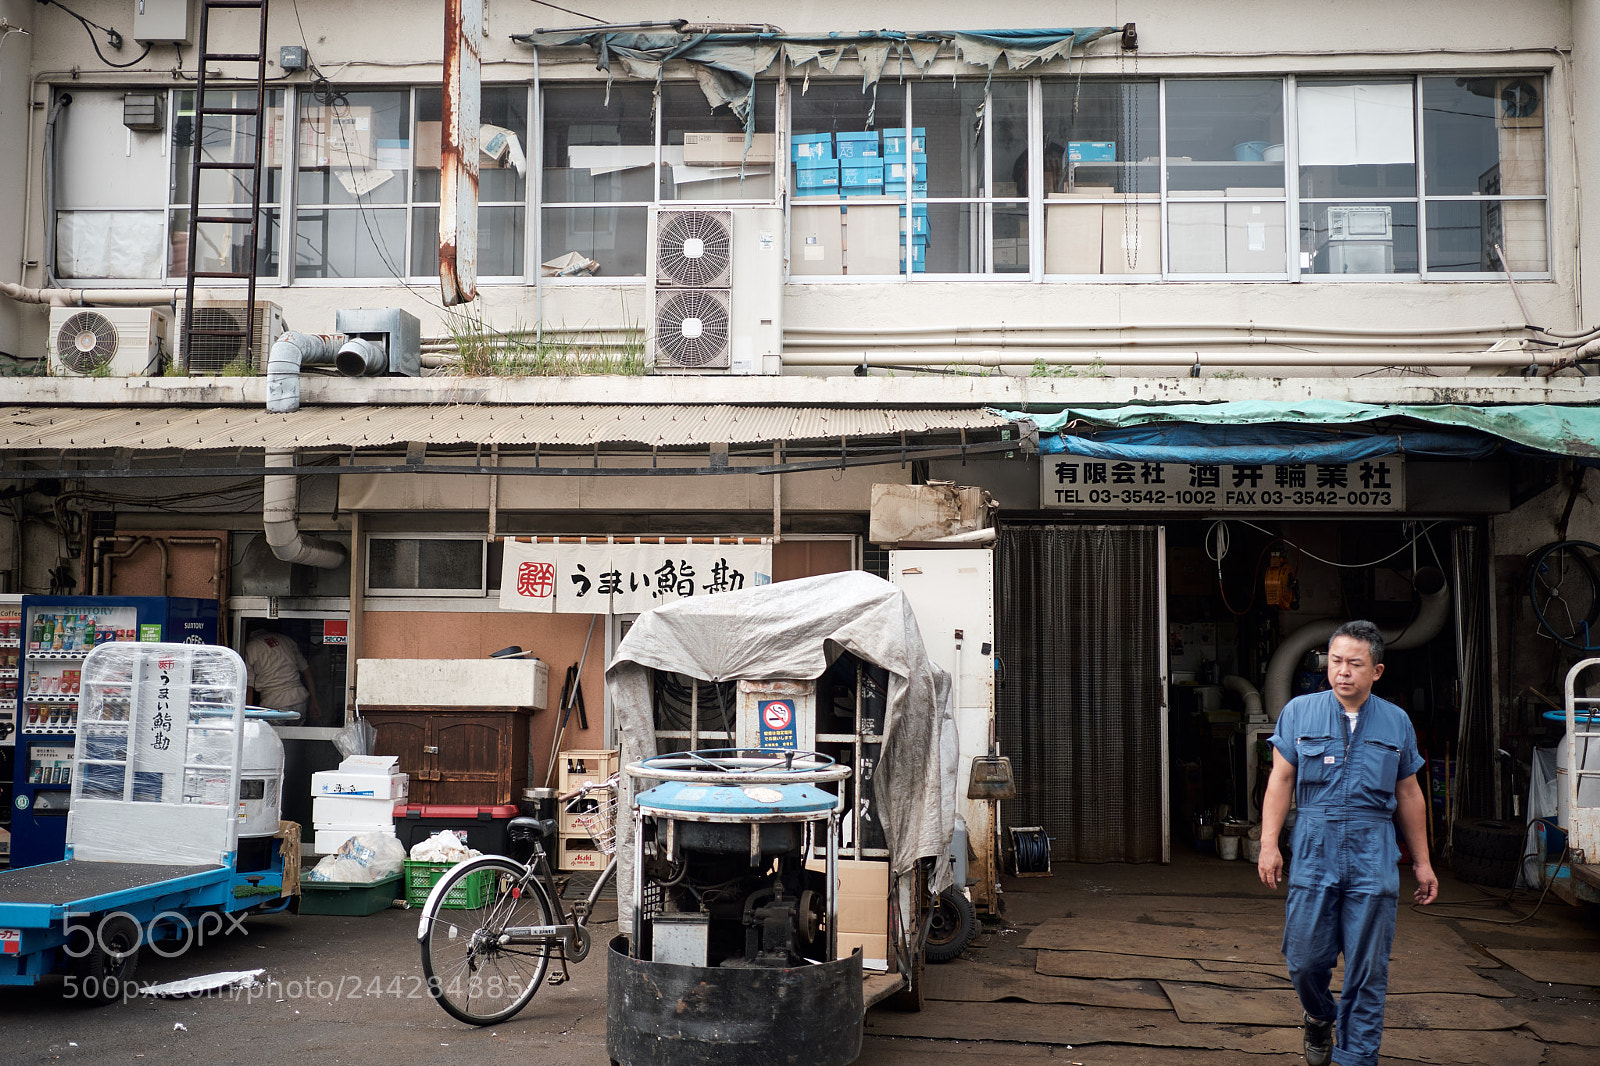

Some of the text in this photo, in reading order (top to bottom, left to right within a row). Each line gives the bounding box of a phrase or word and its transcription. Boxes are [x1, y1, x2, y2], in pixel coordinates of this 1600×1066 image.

[840, 147, 853, 157] A3
[845, 174, 857, 184] A4
[1055, 462, 1391, 488] 有限会社 酒井輪業社
[1055, 489, 1216, 505] TEL 03-3542-1002
[1226, 490, 1392, 505] FAX 03-3542-0073
[64, 607, 114, 615] SUNTORY
[182, 634, 205, 645] OFFE
[150, 670, 173, 751] うまい鮨勘
